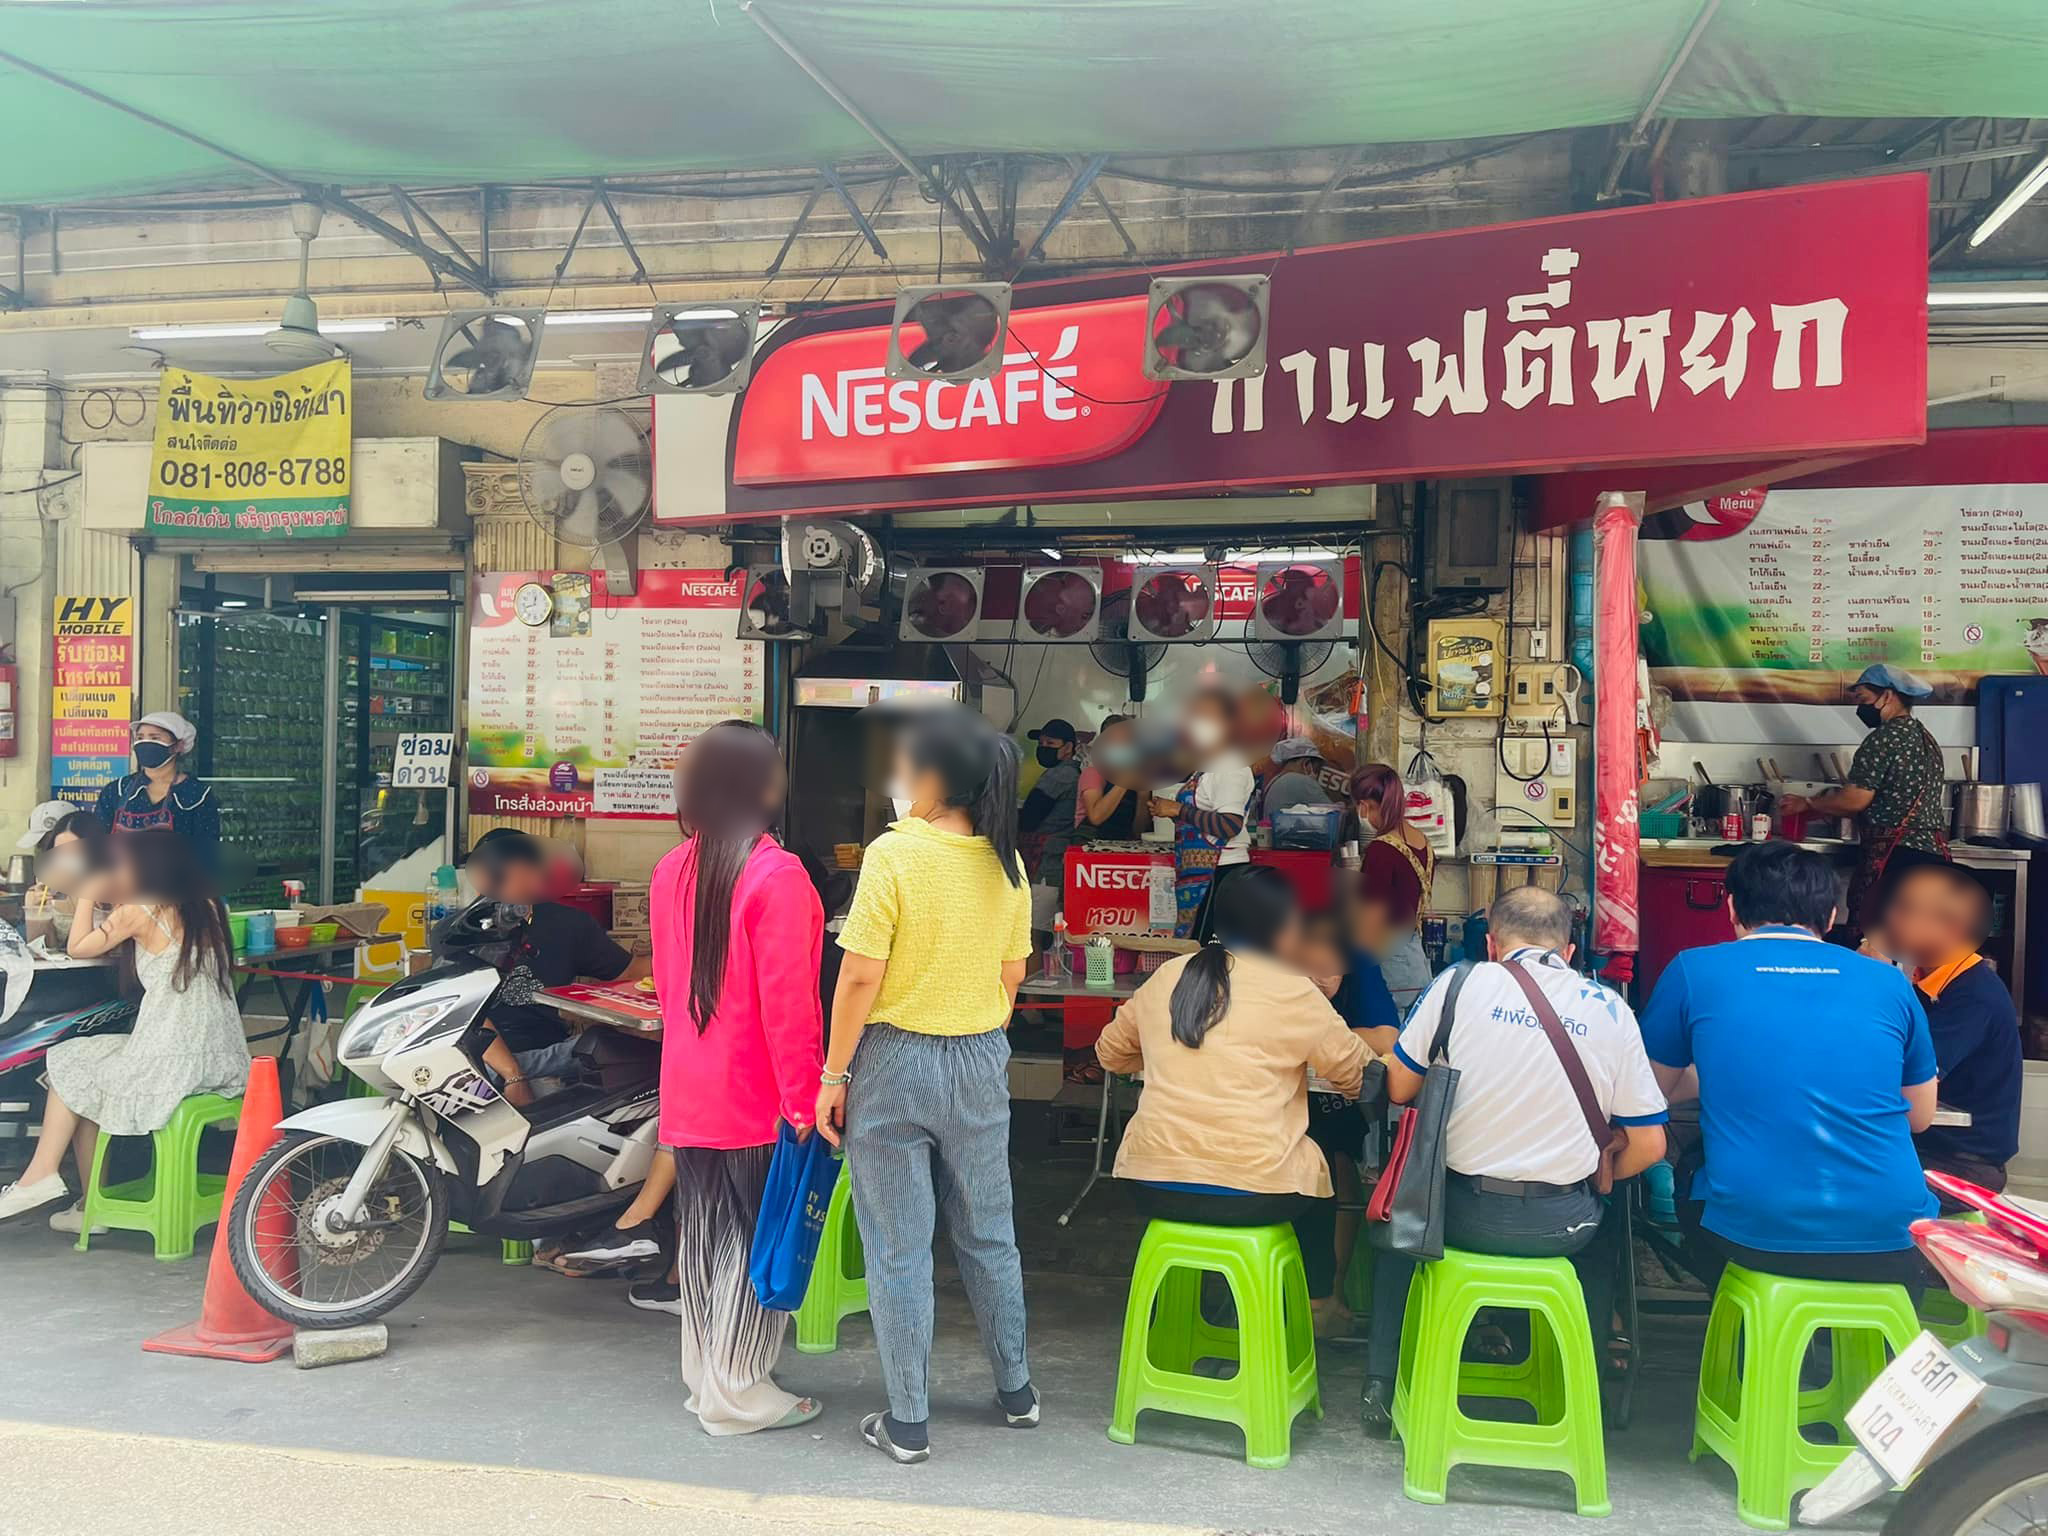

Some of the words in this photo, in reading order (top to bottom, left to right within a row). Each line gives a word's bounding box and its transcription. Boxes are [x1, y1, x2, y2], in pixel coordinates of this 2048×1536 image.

[802, 326, 1079, 440] NESCAFÉ
[160, 457, 345, 489] 081-808-8788
[1720, 497, 1754, 510] Menu
[59, 597, 128, 621] HY
[58, 624, 124, 635] MOBILE
[57, 637, 125, 663] รับซ่อม
[401, 733, 452, 756] ซ่อม
[398, 759, 447, 784] ด่วน
[1086, 907, 1137, 928] หอม
[1861, 1403, 1905, 1453] 104
